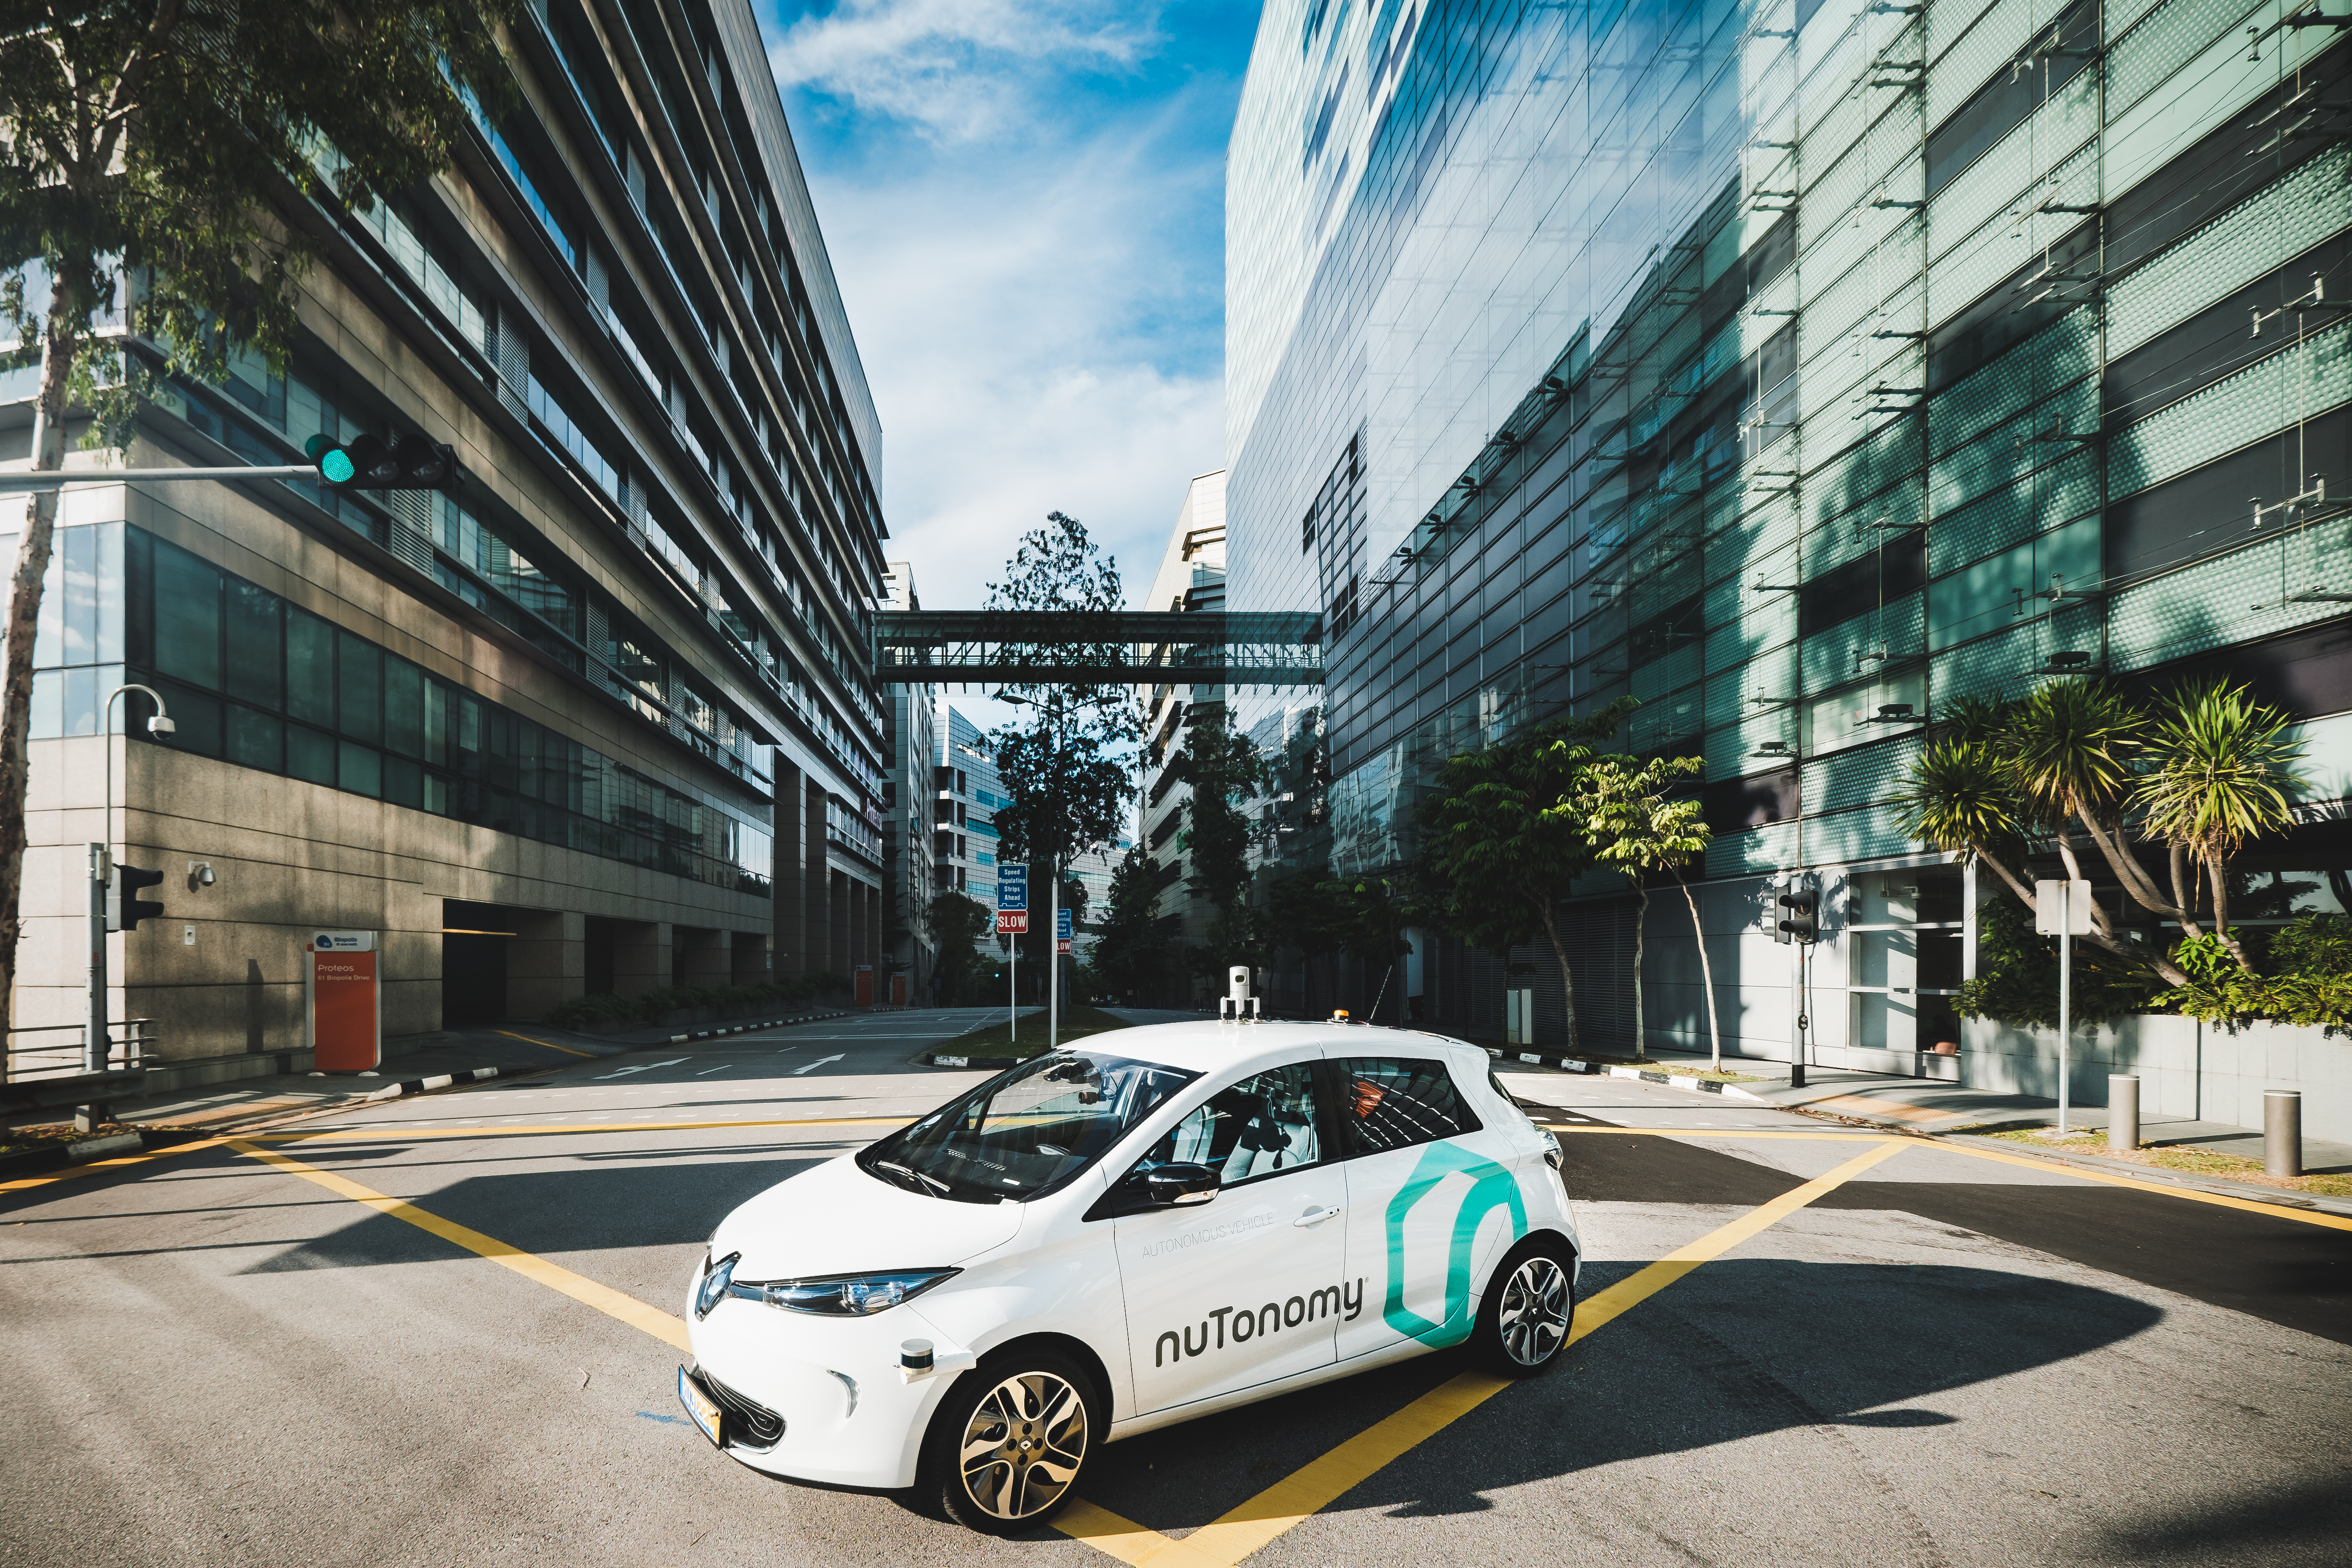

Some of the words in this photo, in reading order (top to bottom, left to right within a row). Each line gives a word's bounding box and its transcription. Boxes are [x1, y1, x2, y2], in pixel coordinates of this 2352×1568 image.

[998, 916, 1026, 927] SLOW
[1143, 1225, 1226, 1259] AUTONOMOUS
[1228, 1213, 1275, 1234] VEHICLE
